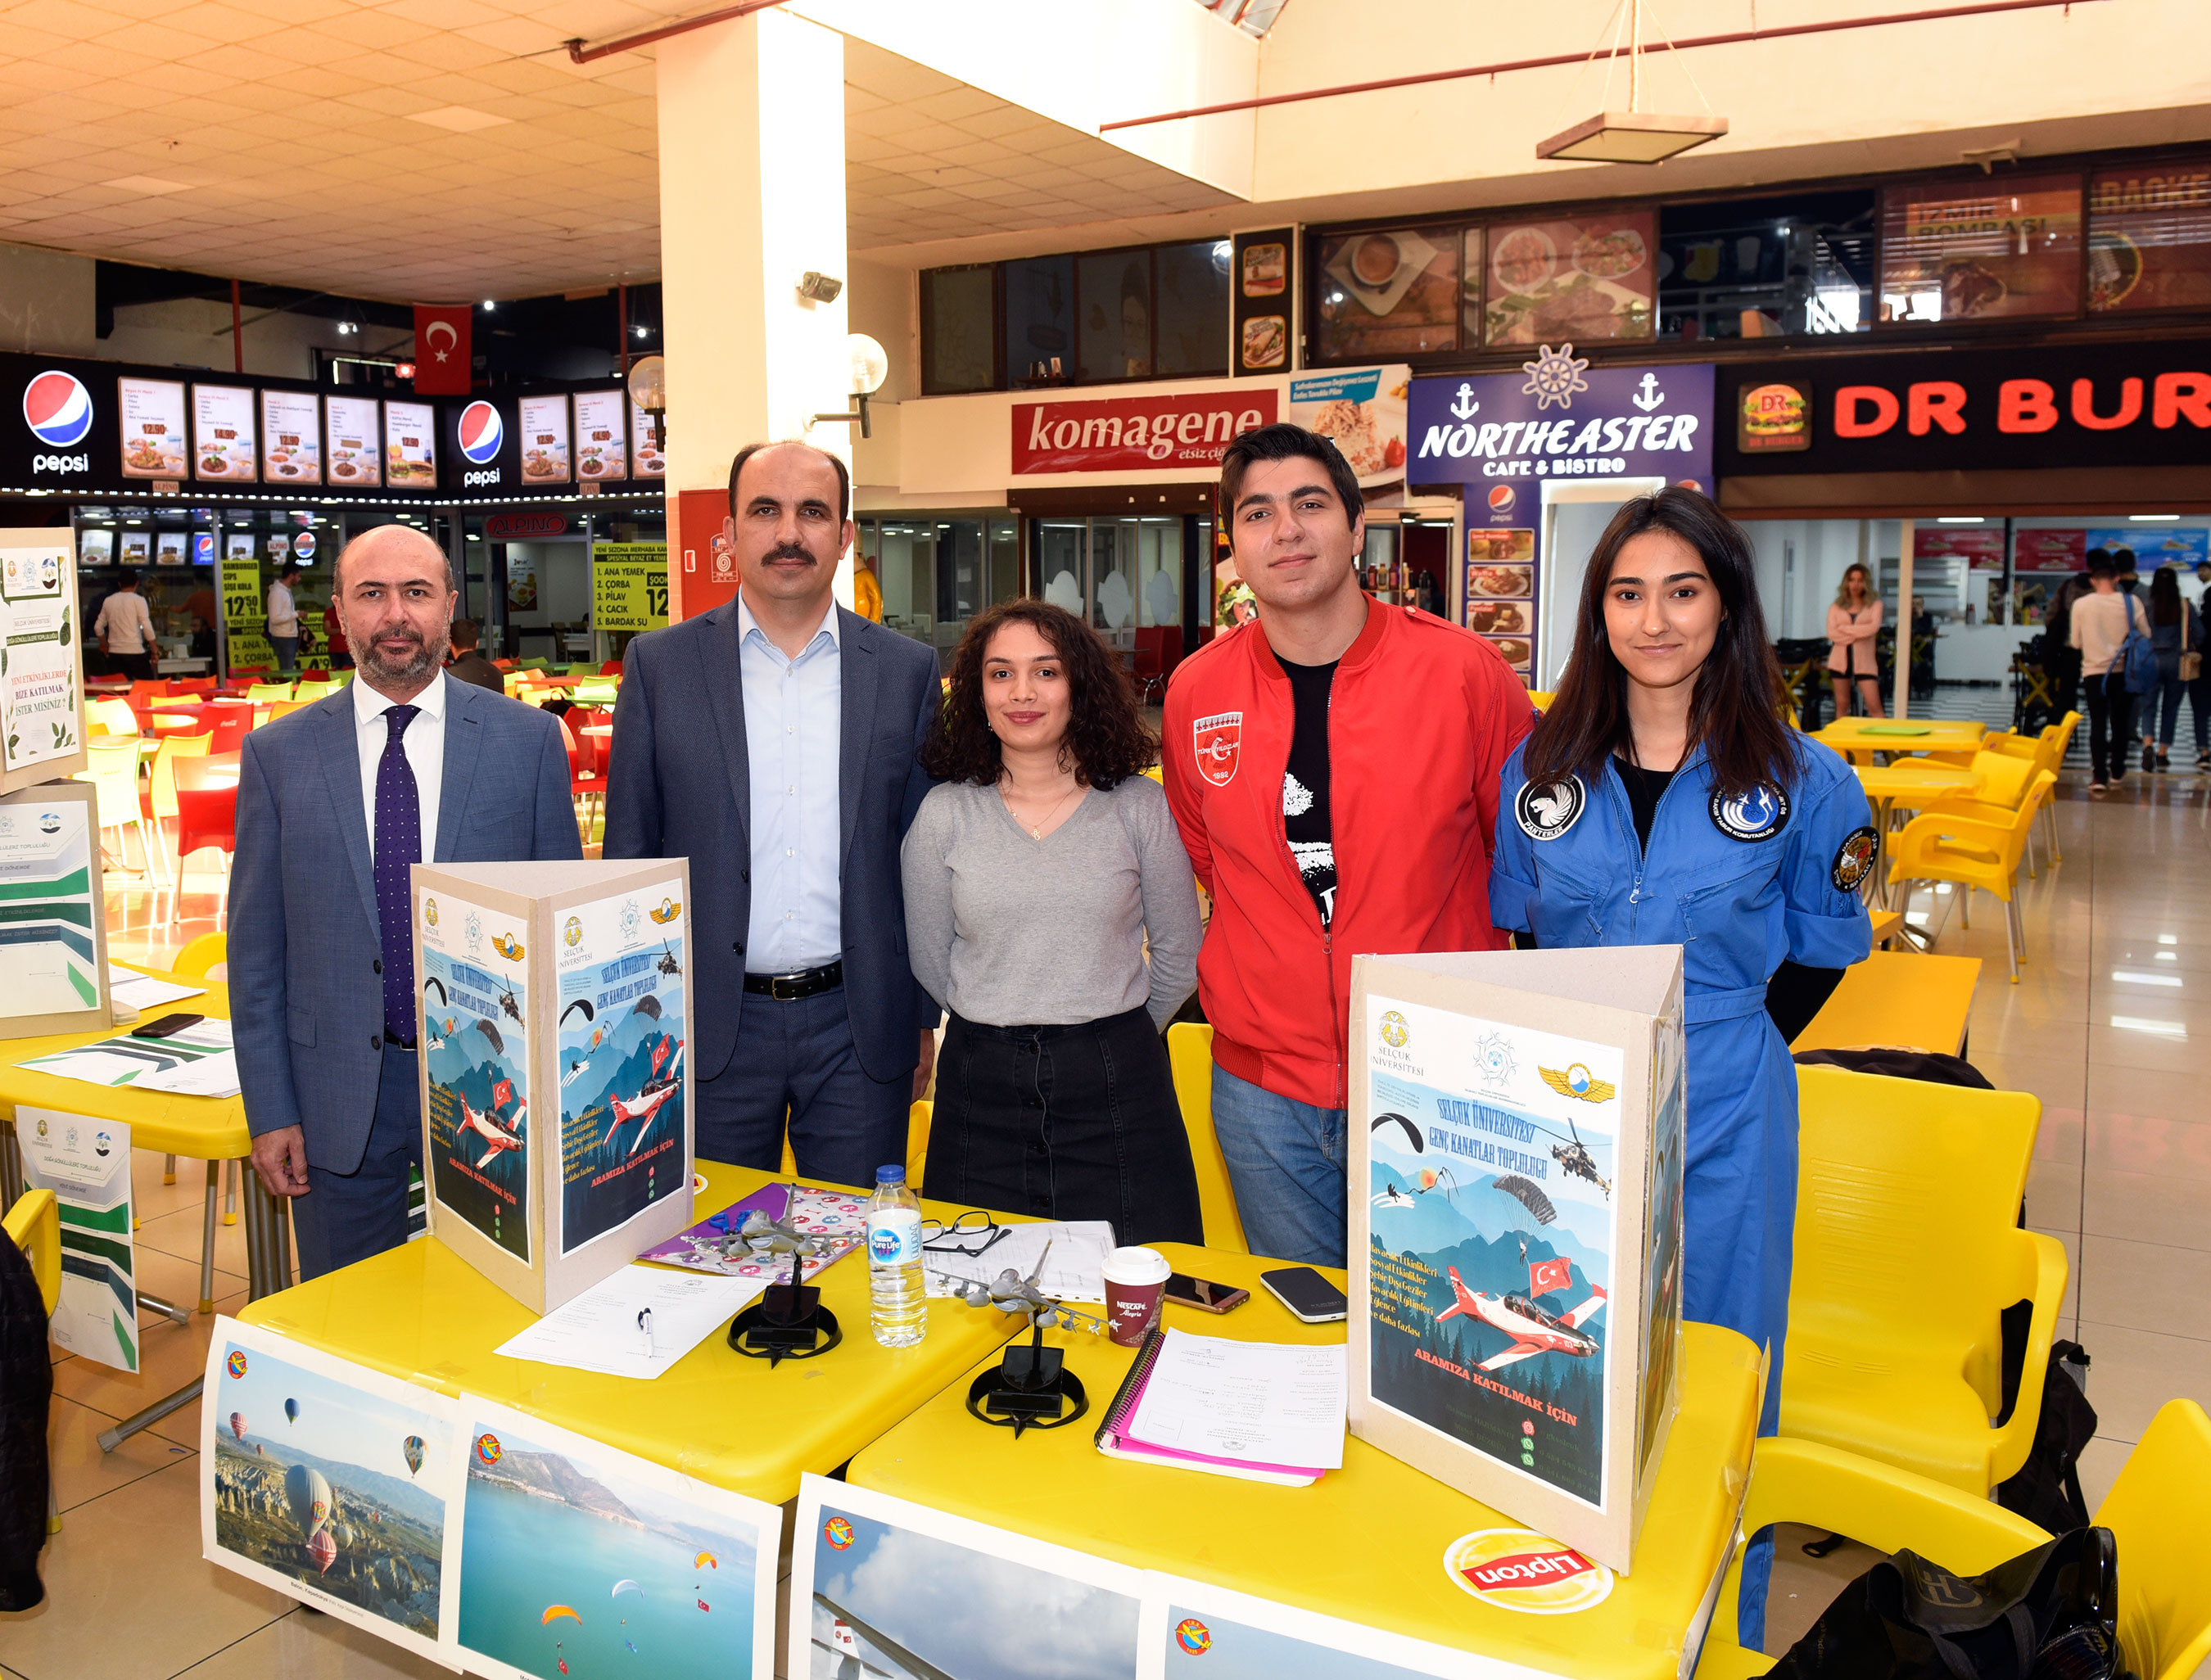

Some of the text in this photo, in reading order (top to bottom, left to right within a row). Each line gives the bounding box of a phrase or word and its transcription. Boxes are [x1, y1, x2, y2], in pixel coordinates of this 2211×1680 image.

[1761, 395, 1787, 411] DR
[1834, 381, 1967, 438] DR
[1029, 406, 1263, 460] komagene
[1418, 414, 1699, 458] NORTHEASTER
[33, 452, 89, 474] pepsi
[1179, 448, 1206, 460] etsiz
[1483, 460, 1531, 476] CAFE
[1535, 458, 1549, 475] &
[463, 467, 501, 488] pepsi
[223, 562, 258, 571] HAMBURGER
[604, 568, 621, 576] ANA
[622, 567, 645, 576] YEMEK
[237, 582, 252, 590] KOLA
[605, 580, 631, 590] ÇORBA
[605, 592, 626, 601] PİLAV
[606, 605, 628, 613] CACIK
[605, 617, 635, 626] BARDAK
[637, 618, 648, 626] SU
[242, 640, 260, 650] ANA
[23, 669, 68, 684] ETKİNLİKLERDE
[15, 684, 64, 700] BİZE KATILMAK
[16, 703, 34, 717] İSTER
[34, 697, 61, 713] MİSİNİZ
[1212, 770, 1229, 779] 1992
[1524, 821, 1563, 838] PANTERLER
[563, 946, 585, 959] SELÇUK
[1378, 1045, 1412, 1062] SELÇUK
[1436, 1098, 1472, 1127] SELÇUK
[1429, 1126, 1449, 1154] GENÇ
[1450, 1132, 1495, 1165] KANATLAR
[590, 1138, 675, 1188] ARAMIZA KATILMAK İÇİN
[448, 1157, 517, 1206] ARAMIZA KATILMAK İÇİN
[871, 1240, 900, 1252] Pure Life
[1371, 1254, 1427, 1285] Sosyal Etkinlikler
[1399, 1254, 1437, 1278] Etkinlikleri
[1370, 1267, 1427, 1298] Şehir Dışı Geziler
[1371, 1294, 1396, 1313] Eğlence
[1399, 1293, 1435, 1316] Eğitimleri
[1119, 1309, 1142, 1318] Alegria
[1379, 1312, 1397, 1327] daha
[1397, 1319, 1421, 1338] fazlası
[1413, 1347, 1578, 1427] ARAMIZA KATILMAK İÇİN
[1475, 1554, 1583, 1584] Lipton
